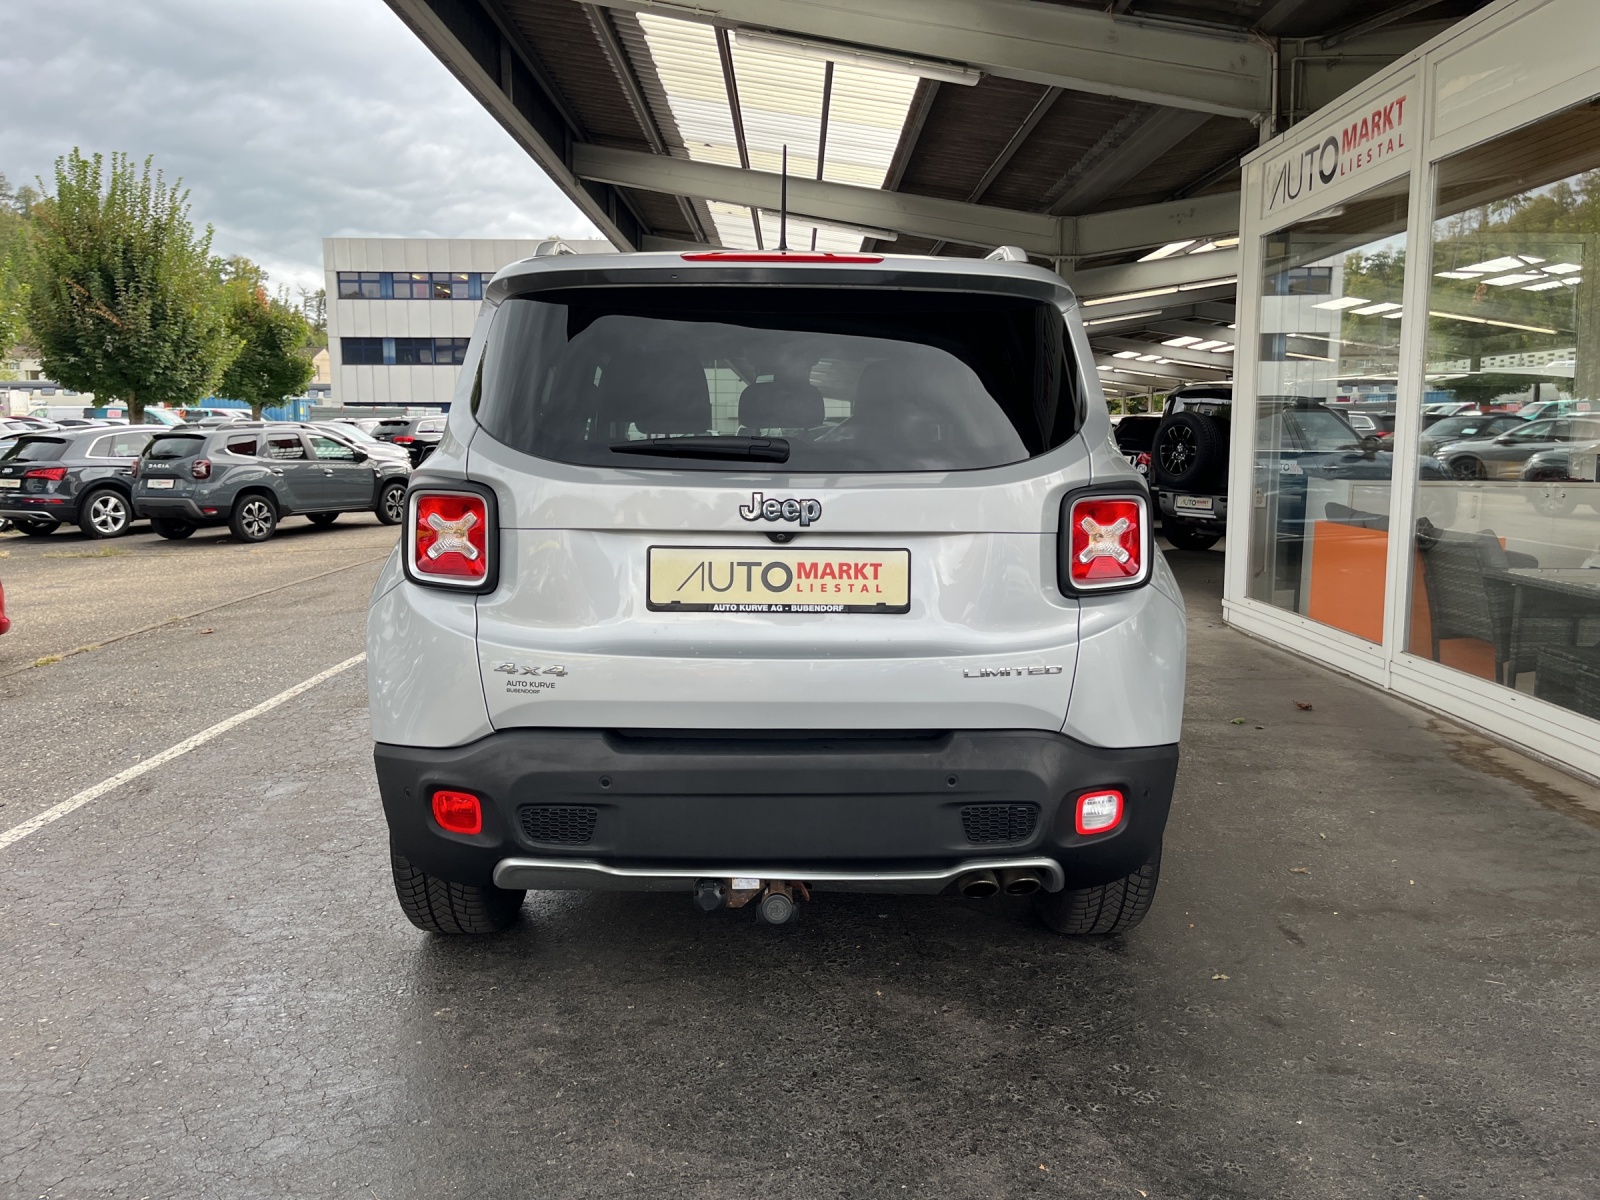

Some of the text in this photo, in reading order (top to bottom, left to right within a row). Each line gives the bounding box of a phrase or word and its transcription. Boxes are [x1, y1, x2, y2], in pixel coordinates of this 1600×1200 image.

[1269, 95, 1406, 210] AUTO MARKT
[1340, 133, 1404, 176] LIESTAL
[739, 491, 822, 527] Jeep
[676, 561, 883, 593] AUTO MARKT
[796, 583, 883, 593] LIESTAL
[739, 604, 768, 612] KURVE
[770, 604, 783, 612] AG
[791, 604, 844, 612] BUBENDORF
[963, 665, 1063, 678] LIMITED
[529, 681, 556, 689] KURVE
